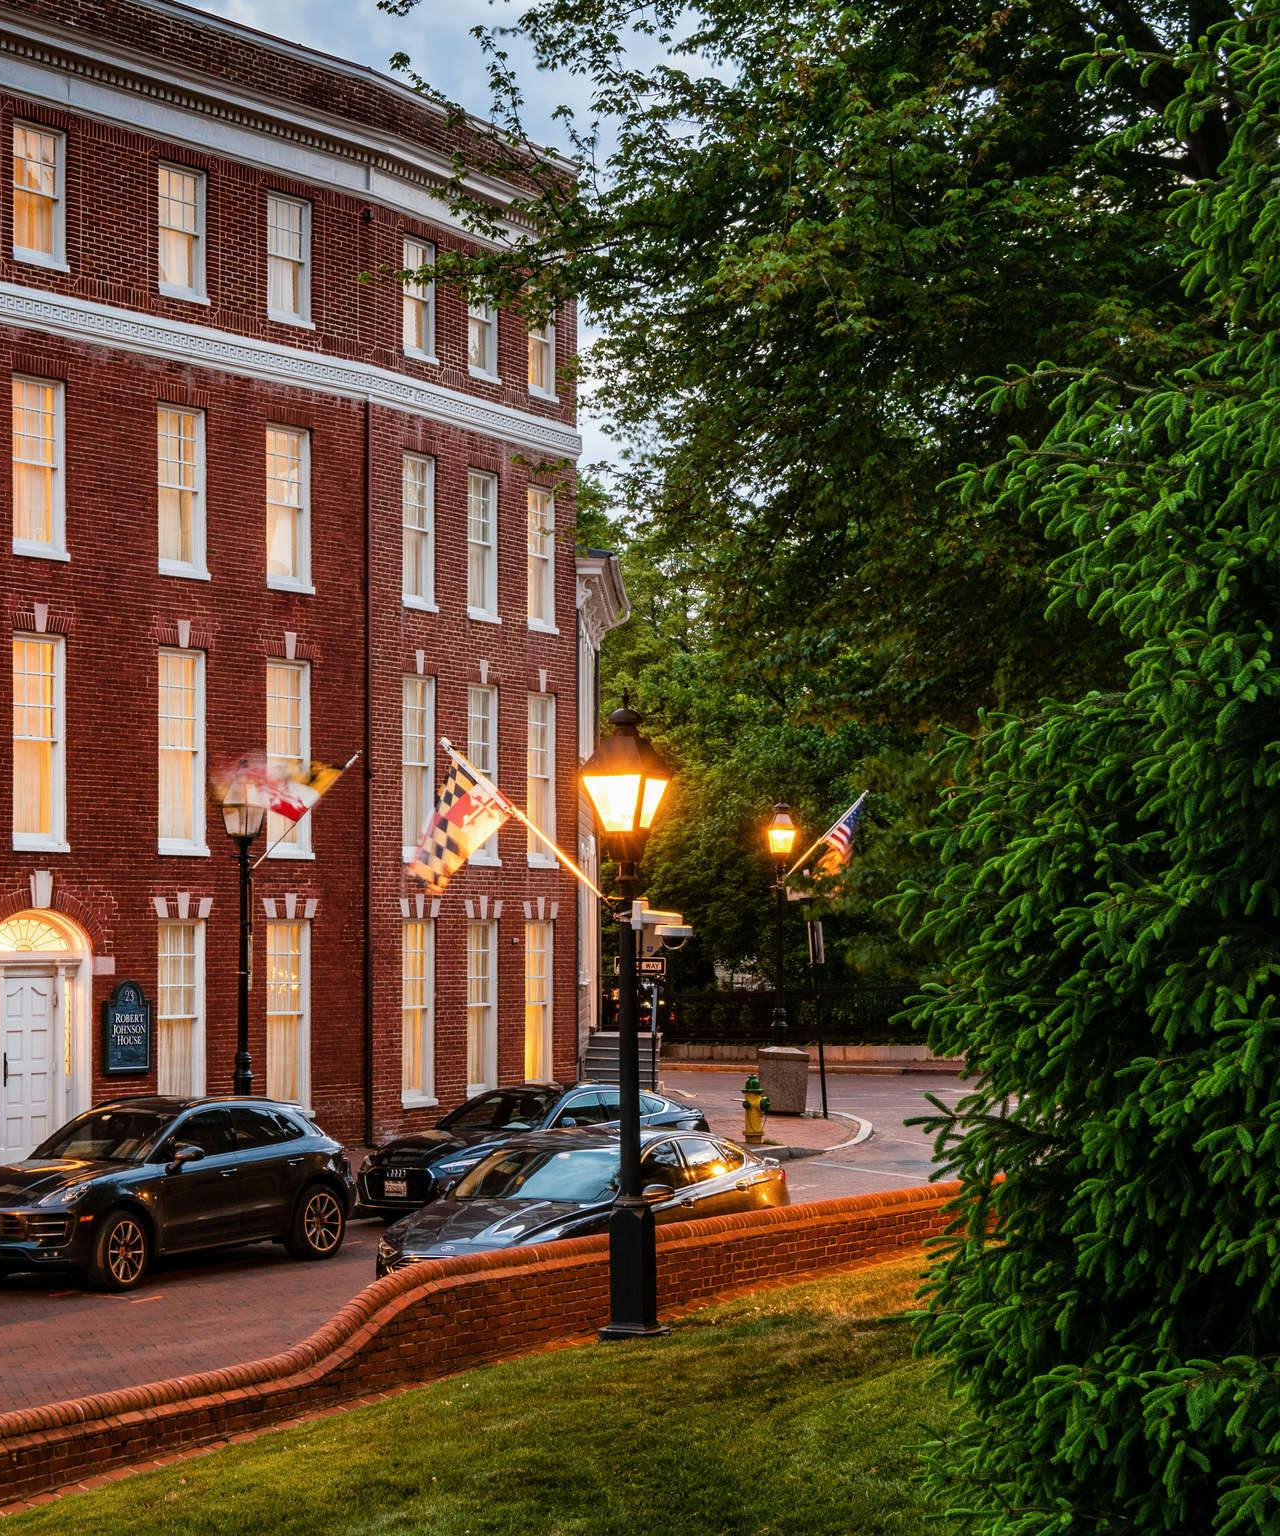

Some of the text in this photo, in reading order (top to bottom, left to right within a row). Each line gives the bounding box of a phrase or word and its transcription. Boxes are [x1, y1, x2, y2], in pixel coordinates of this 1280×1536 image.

[124, 990, 135, 1001] 23
[115, 1013, 145, 1023] ROBERT
[111, 1024, 147, 1037] JOHNSON
[117, 1035, 143, 1045] HOUSE
